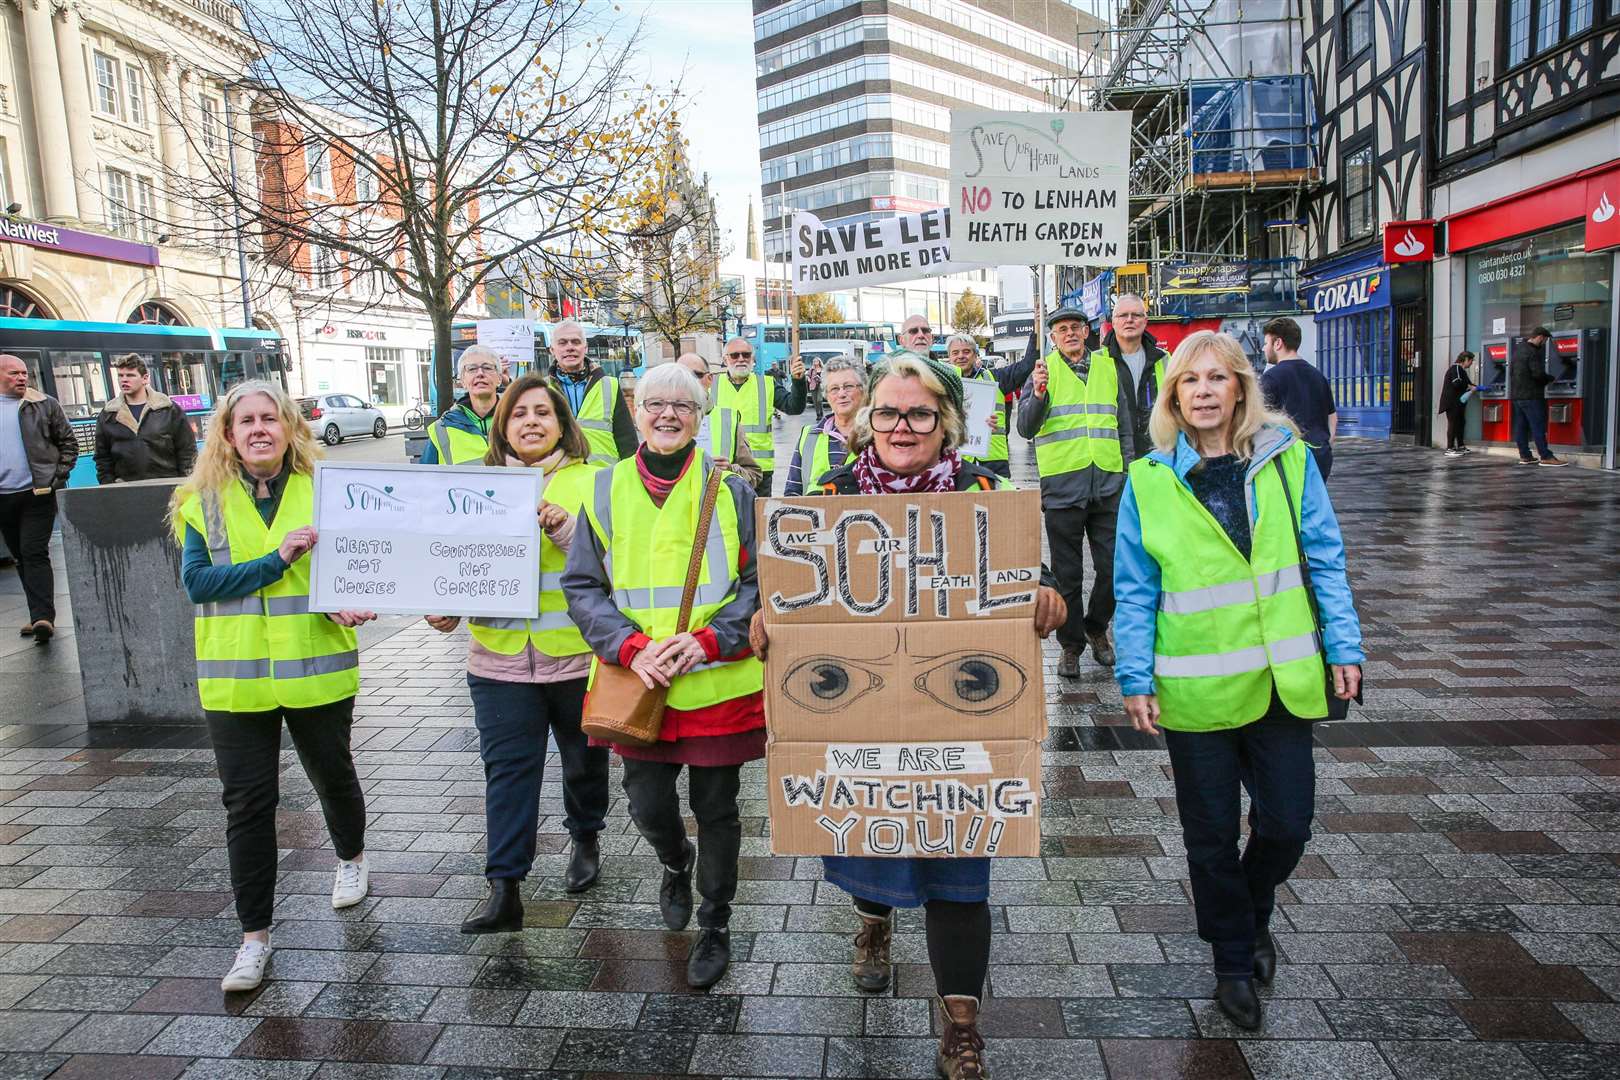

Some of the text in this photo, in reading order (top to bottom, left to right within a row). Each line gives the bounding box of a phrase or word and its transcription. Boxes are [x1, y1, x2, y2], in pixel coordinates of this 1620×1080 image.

[964, 126, 1100, 178] SAVE OUR HEATH LANDS
[961, 186, 1117, 214] NO TO LENHAM
[0, 219, 60, 245] NatWest
[798, 220, 883, 258] SAVE
[968, 221, 1103, 242] HEATH GARDEN
[1061, 242, 1117, 257] TOWN
[1478, 246, 1532, 269] santander.co.uk
[799, 259, 849, 281] FROM
[856, 251, 912, 275] MORE
[1478, 264, 1526, 284] 0800 030 4321
[1314, 278, 1370, 314] CORAL
[335, 536, 392, 554] HEATH
[429, 541, 527, 558] COUNTRYSIDE
[347, 558, 382, 574] NOT
[459, 561, 492, 577] NOT
[334, 576, 396, 595] HOUSES
[433, 576, 521, 597] CONCRETE
[832, 747, 966, 771] WE ARE
[783, 775, 1033, 815] WATCHING
[819, 816, 1005, 854] YOU!!
